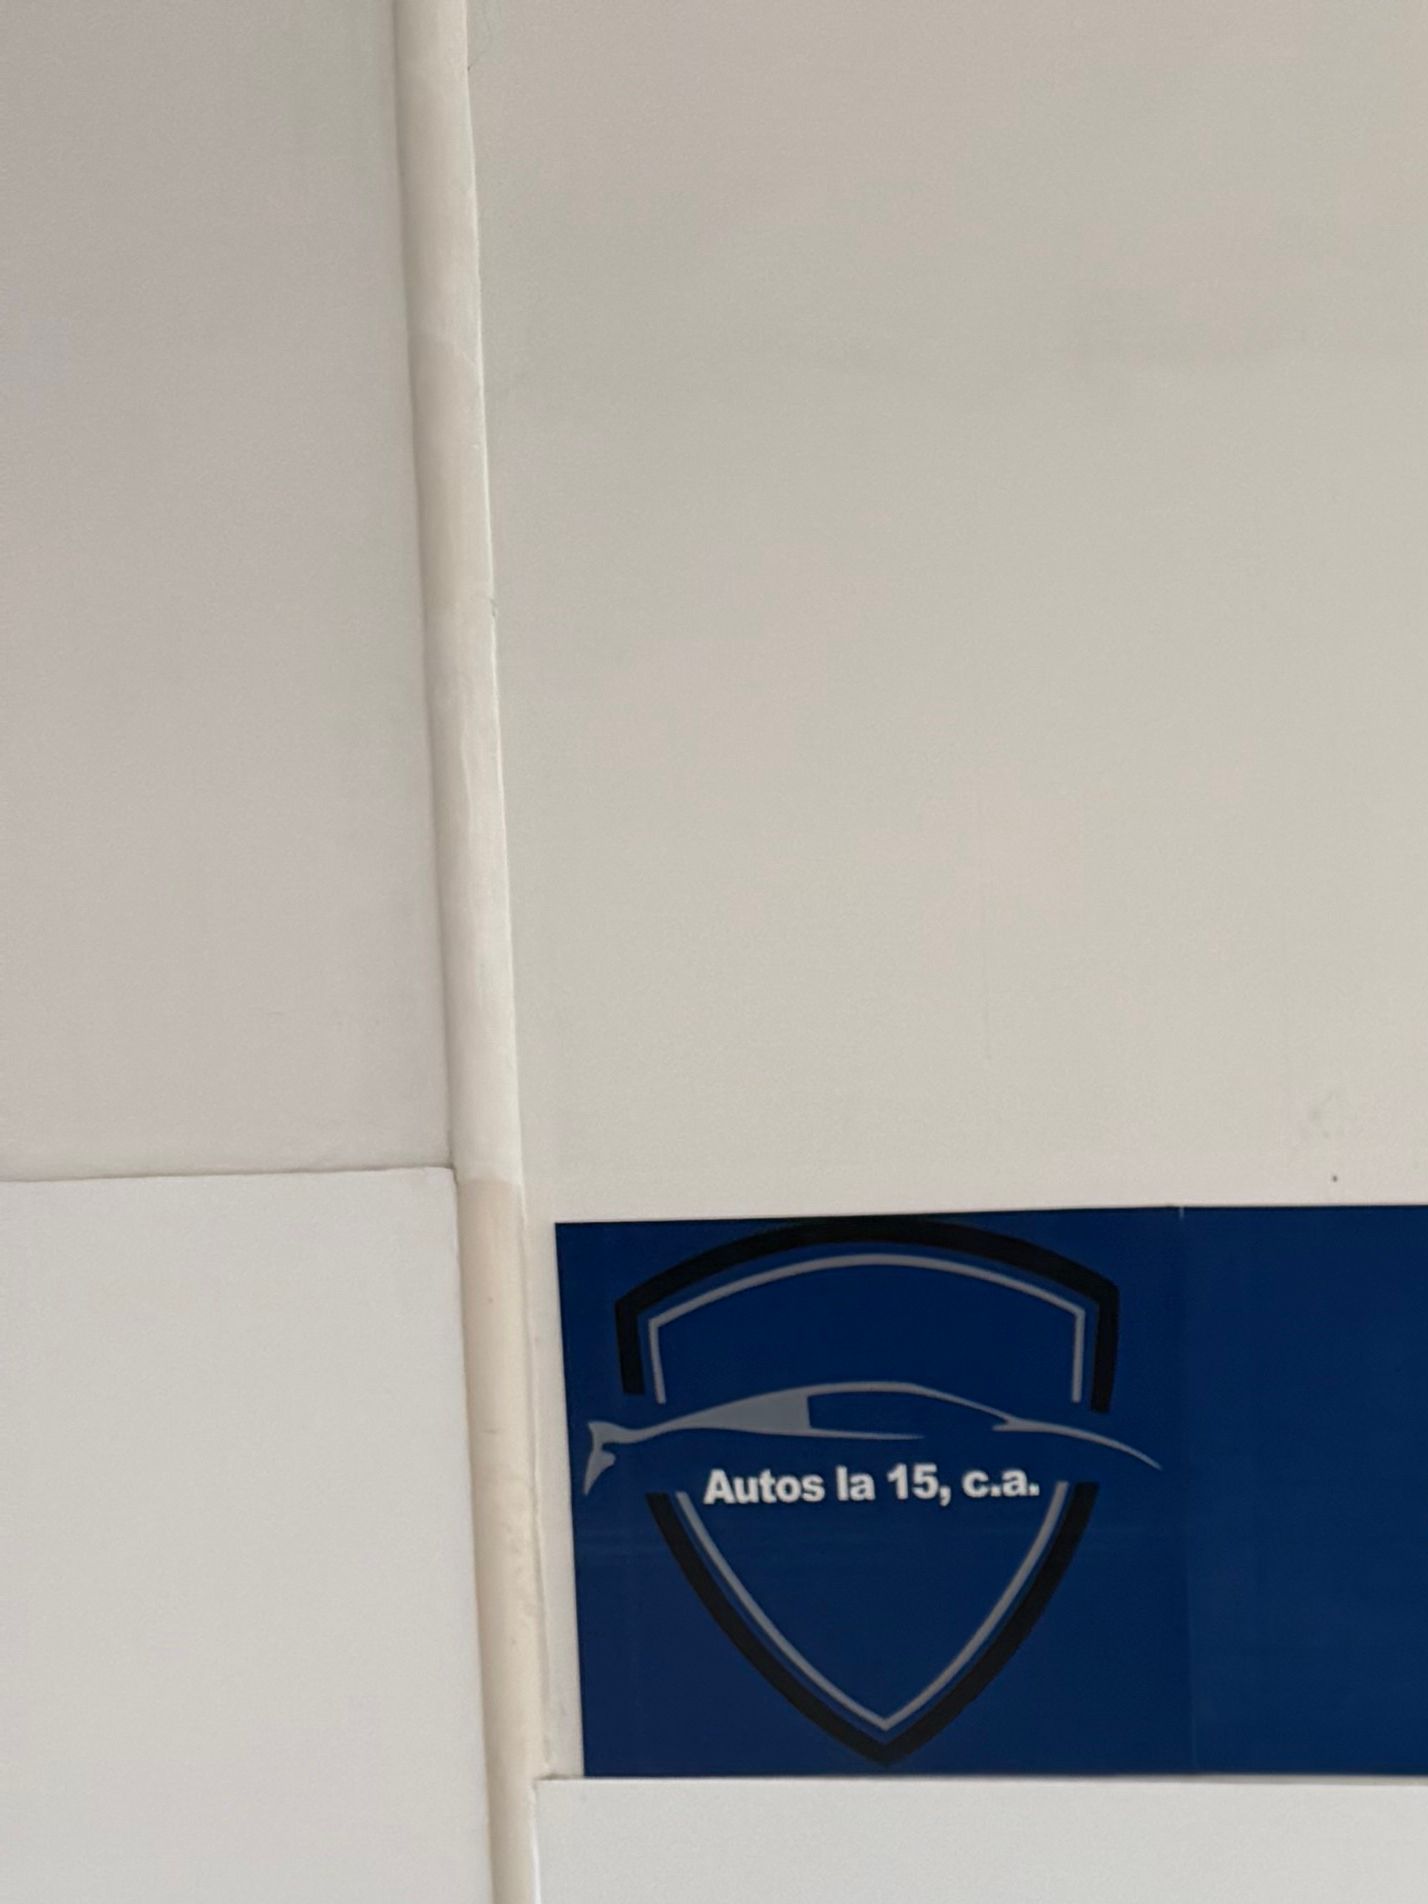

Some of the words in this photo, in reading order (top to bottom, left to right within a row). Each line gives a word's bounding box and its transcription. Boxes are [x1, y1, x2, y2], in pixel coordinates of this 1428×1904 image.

[704, 1469, 825, 1504] Autos
[836, 1466, 875, 1501] la
[888, 1464, 951, 1506] 15,
[963, 1470, 1040, 1497] c.a.
